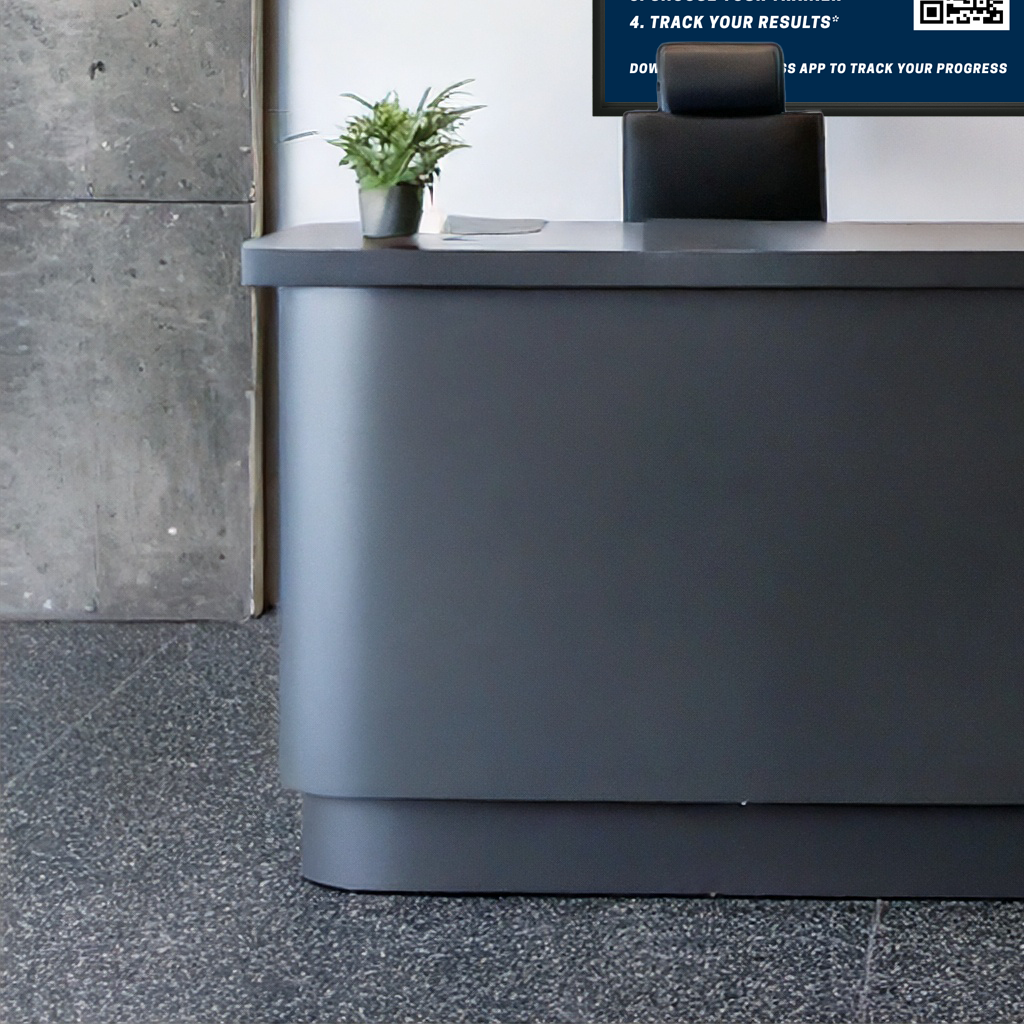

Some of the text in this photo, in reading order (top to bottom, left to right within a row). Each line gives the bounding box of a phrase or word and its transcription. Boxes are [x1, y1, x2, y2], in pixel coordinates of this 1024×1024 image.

[629, 15, 645, 29] 4.
[650, 15, 705, 29] TRACK
[709, 15, 754, 29] YOUR
[798, 62, 826, 74] APP
[829, 62, 847, 74] TO
[850, 62, 894, 74] TRACK
[897, 62, 933, 74] YOUR
[936, 62, 1008, 74] PROGRESS
